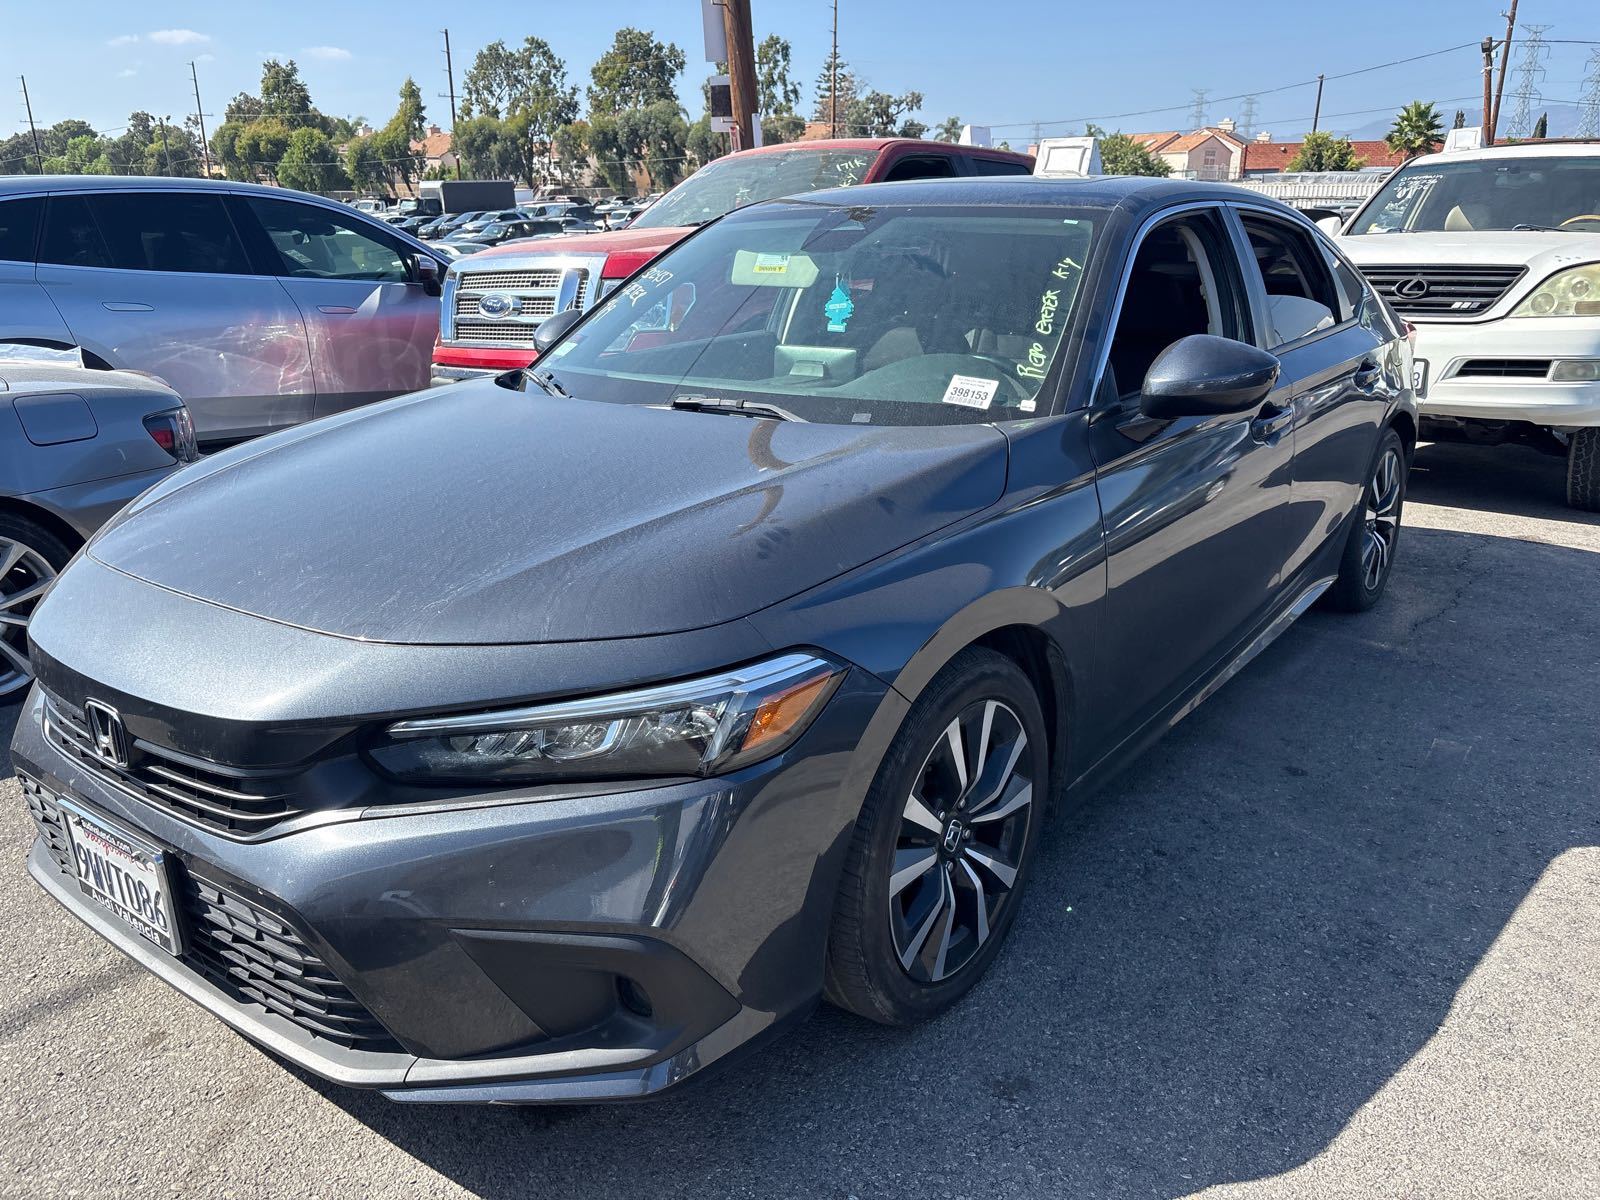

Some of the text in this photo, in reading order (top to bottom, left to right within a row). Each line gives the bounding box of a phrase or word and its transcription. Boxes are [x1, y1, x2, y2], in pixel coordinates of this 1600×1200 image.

[950, 386, 989, 401] 398153
[75, 841, 167, 931] 9WVT086
[91, 888, 160, 945] Audi Valencia
